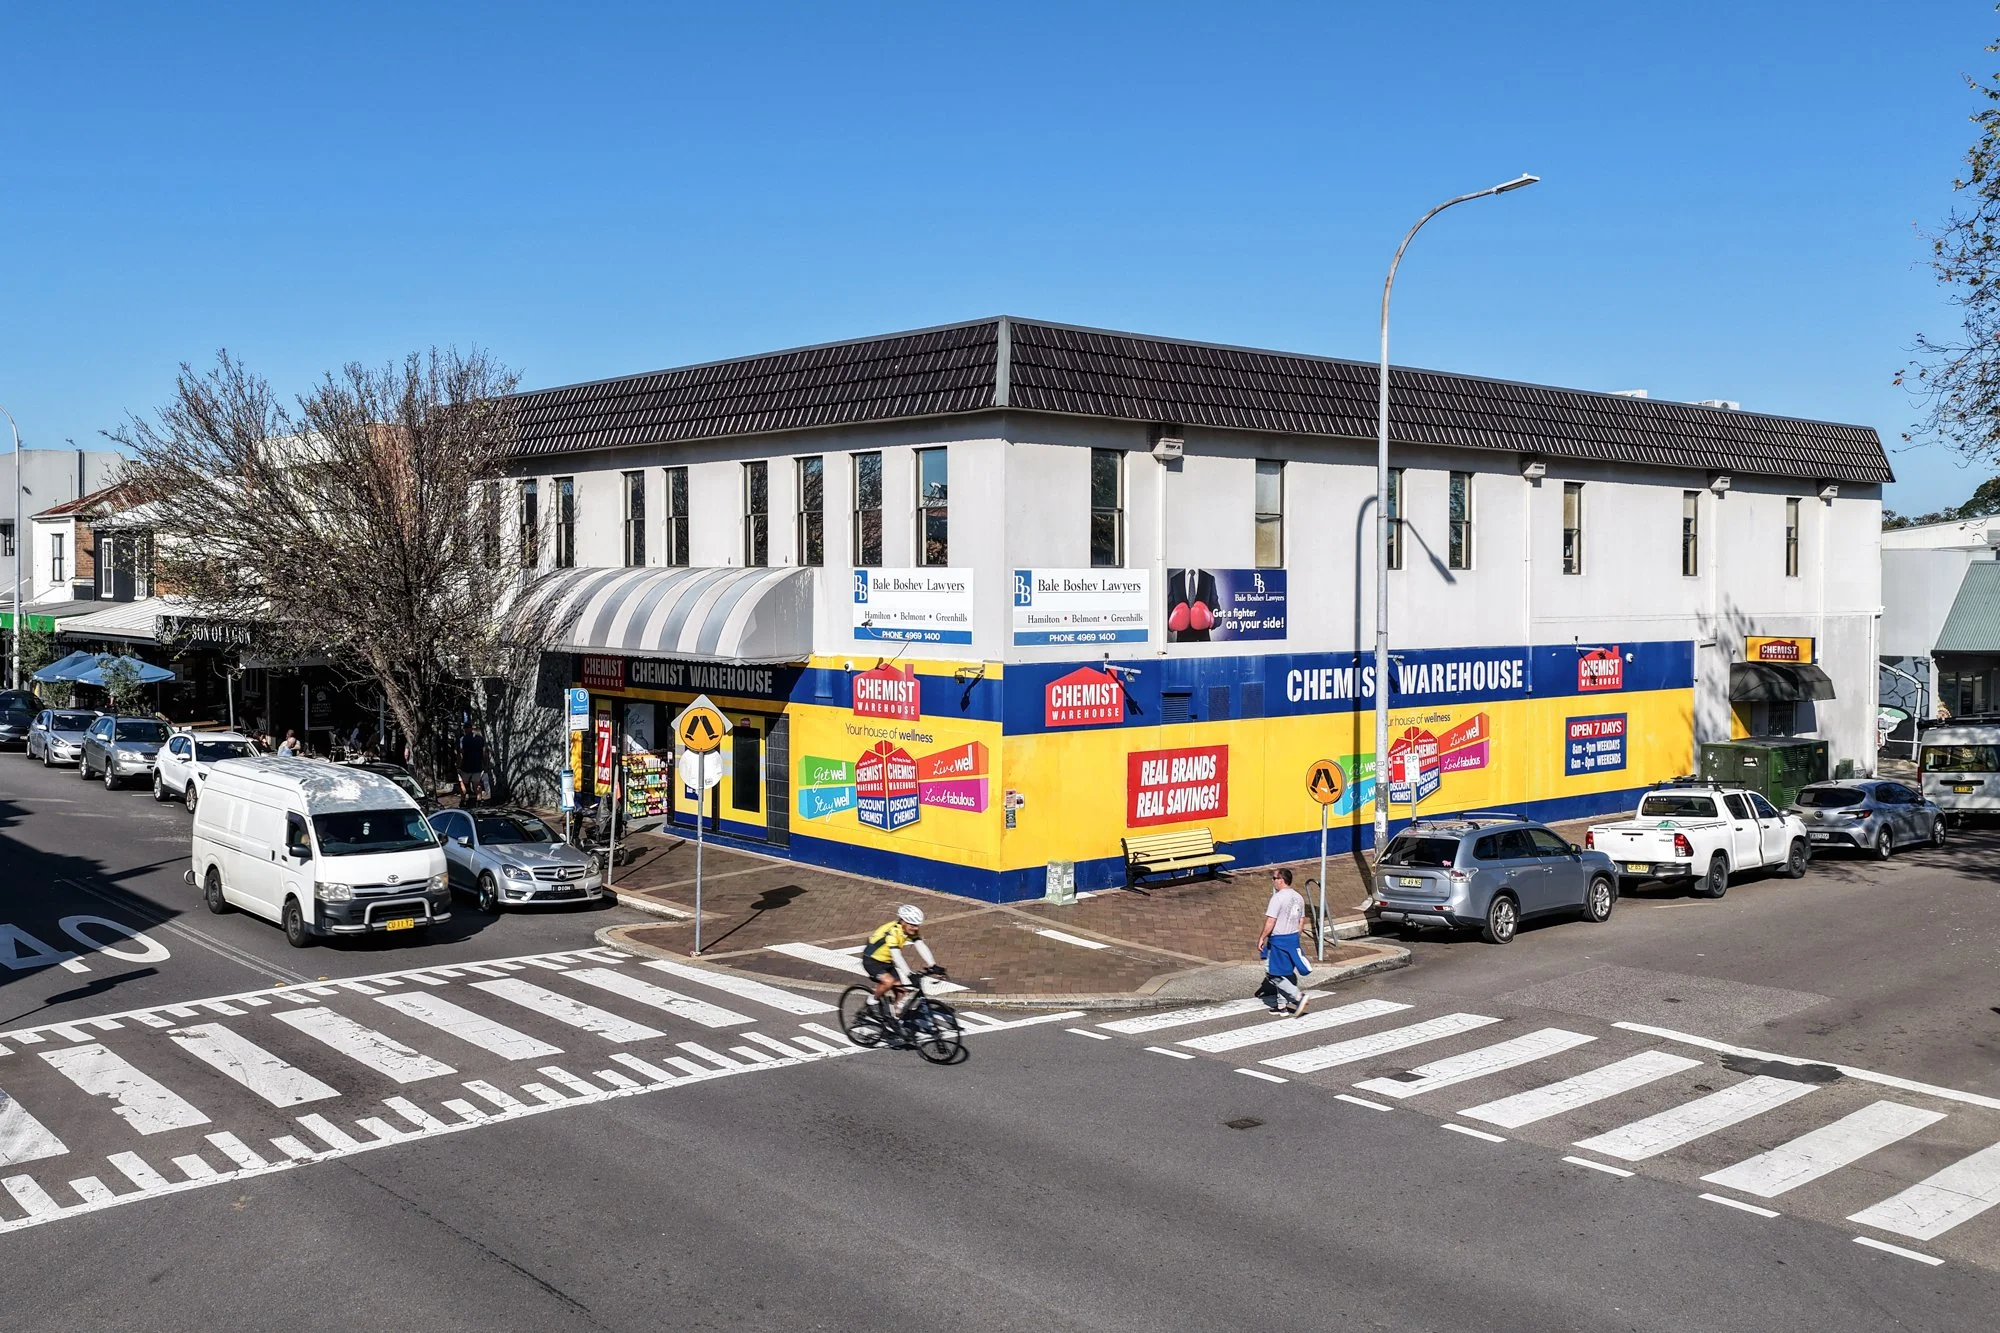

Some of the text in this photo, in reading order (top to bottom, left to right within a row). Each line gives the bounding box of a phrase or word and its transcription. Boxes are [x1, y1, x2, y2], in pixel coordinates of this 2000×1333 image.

[873, 578, 965, 593] Bale Boshev Lawyers
[1038, 579, 1141, 593] Bale Boshev Lawyers
[1234, 594, 1285, 602] Bale Boshev Lawyers
[864, 610, 968, 622] Hamilton Belmont Greenhills
[1027, 613, 1143, 624] Hamilton Belmont Greenhills
[1212, 609, 1227, 618] Get
[1233, 608, 1257, 619] fighter
[191, 624, 209, 641] SON
[1226, 617, 1285, 632] on your side!
[881, 630, 940, 640] PHONE 4969 1400
[1049, 632, 1116, 642] PHONE 4969 1400
[1761, 645, 1797, 655] CHEMIST
[583, 657, 623, 677] CHEMIST
[1581, 660, 1620, 677] CHEMIST
[584, 676, 623, 688] WAREHOUSE
[632, 663, 773, 693] CHEMIST WAREHOUSE
[1286, 660, 1493, 702] CHEMIS WAREHOUSE
[857, 678, 915, 703] CHEMIST
[1052, 682, 1120, 707] CHEMIST
[857, 701, 915, 715] WAREHOUSE
[1052, 707, 1120, 721] WAREHOUSE
[1394, 714, 1416, 726] house
[1417, 713, 1424, 724] of
[1424, 712, 1450, 723] wellness
[845, 723, 934, 743] Your house of wellness
[1450, 716, 1479, 747] Live well
[1571, 721, 1622, 738] OPEN 7 DAYS
[599, 731, 609, 764] 7
[1415, 743, 1437, 758] CHEMIST
[1572, 743, 1582, 755] 8am
[1586, 742, 1596, 756] 9pm
[1596, 739, 1620, 752] WEEKDAYS
[933, 744, 973, 776] Live well
[1364, 762, 1376, 773] we
[1444, 755, 1481, 770] Look fabulous
[1571, 758, 1581, 769] 8am
[1585, 756, 1595, 770] 8pm
[1597, 753, 1621, 766] WEEKENDS
[812, 766, 831, 793] Get
[830, 762, 847, 781] well
[856, 763, 883, 783] CHEMIST
[887, 763, 916, 780] CHEMIST
[1140, 754, 1217, 786] REAL BRANDS
[888, 781, 916, 791] WAREHOUSE
[1420, 778, 1438, 797] CHEMIST
[814, 788, 850, 822] Stay well
[889, 796, 917, 813] DISCOUNT
[924, 786, 976, 807] Look fabulous
[1136, 783, 1220, 818] REAL SAVINGS!
[858, 799, 885, 812] DISCOUNT
[860, 810, 883, 825] CHEMIST
[893, 808, 916, 825] CHEMIST
